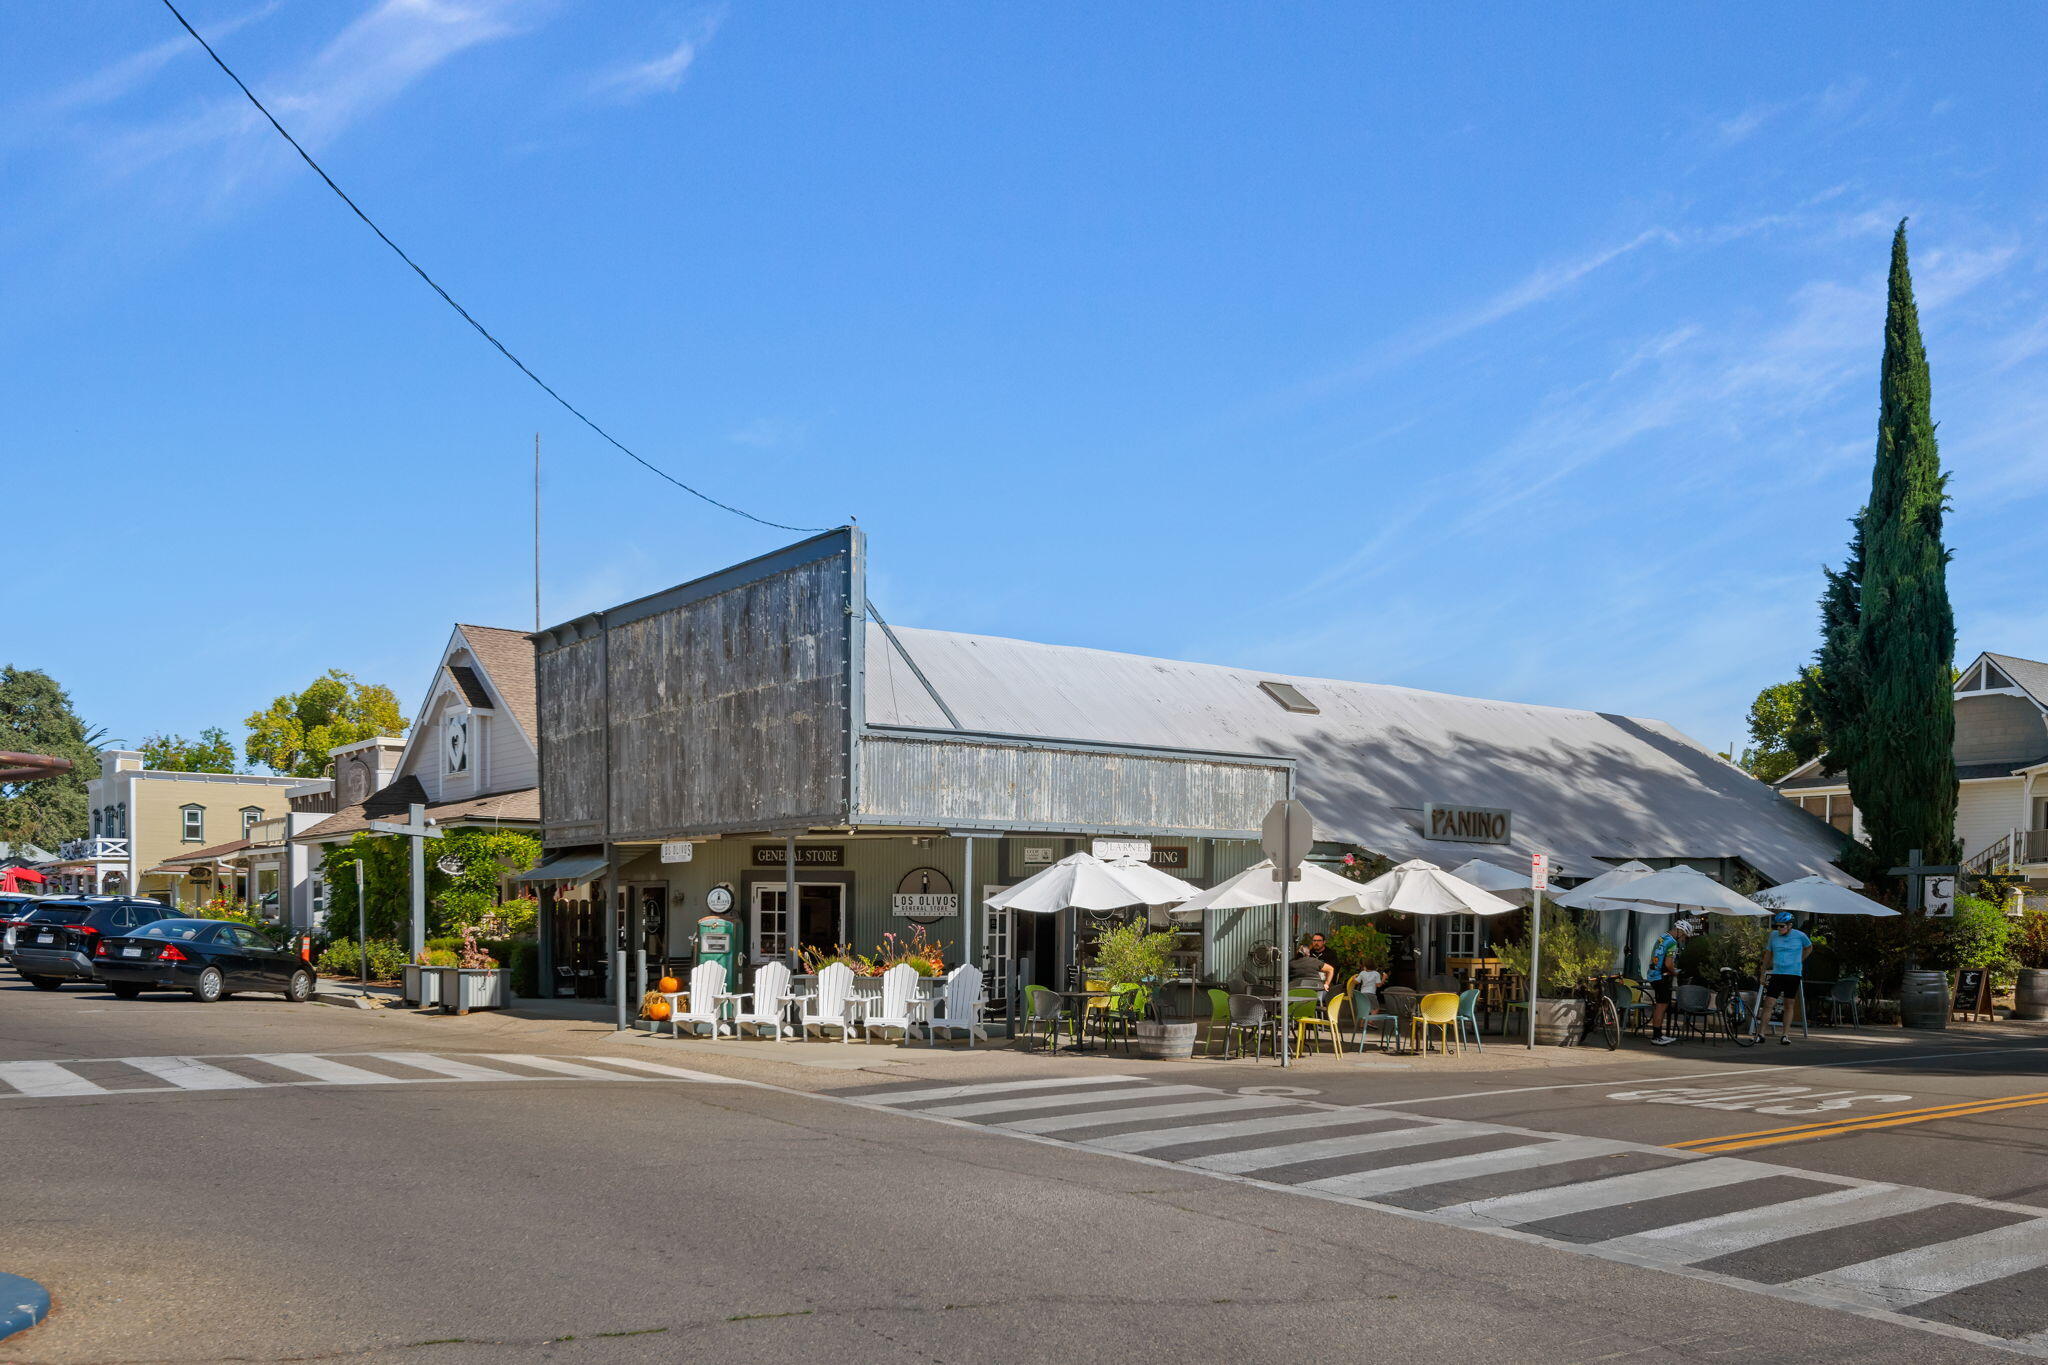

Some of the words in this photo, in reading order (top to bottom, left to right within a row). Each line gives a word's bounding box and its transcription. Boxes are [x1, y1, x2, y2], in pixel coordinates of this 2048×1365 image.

[1431, 809, 1506, 840] PANINO
[1109, 843, 1149, 853] LARNER
[758, 849, 803, 862] GENEAL
[805, 850, 838, 862] STORE
[894, 896, 913, 907] LOS
[919, 896, 957, 908] OLIVOS
